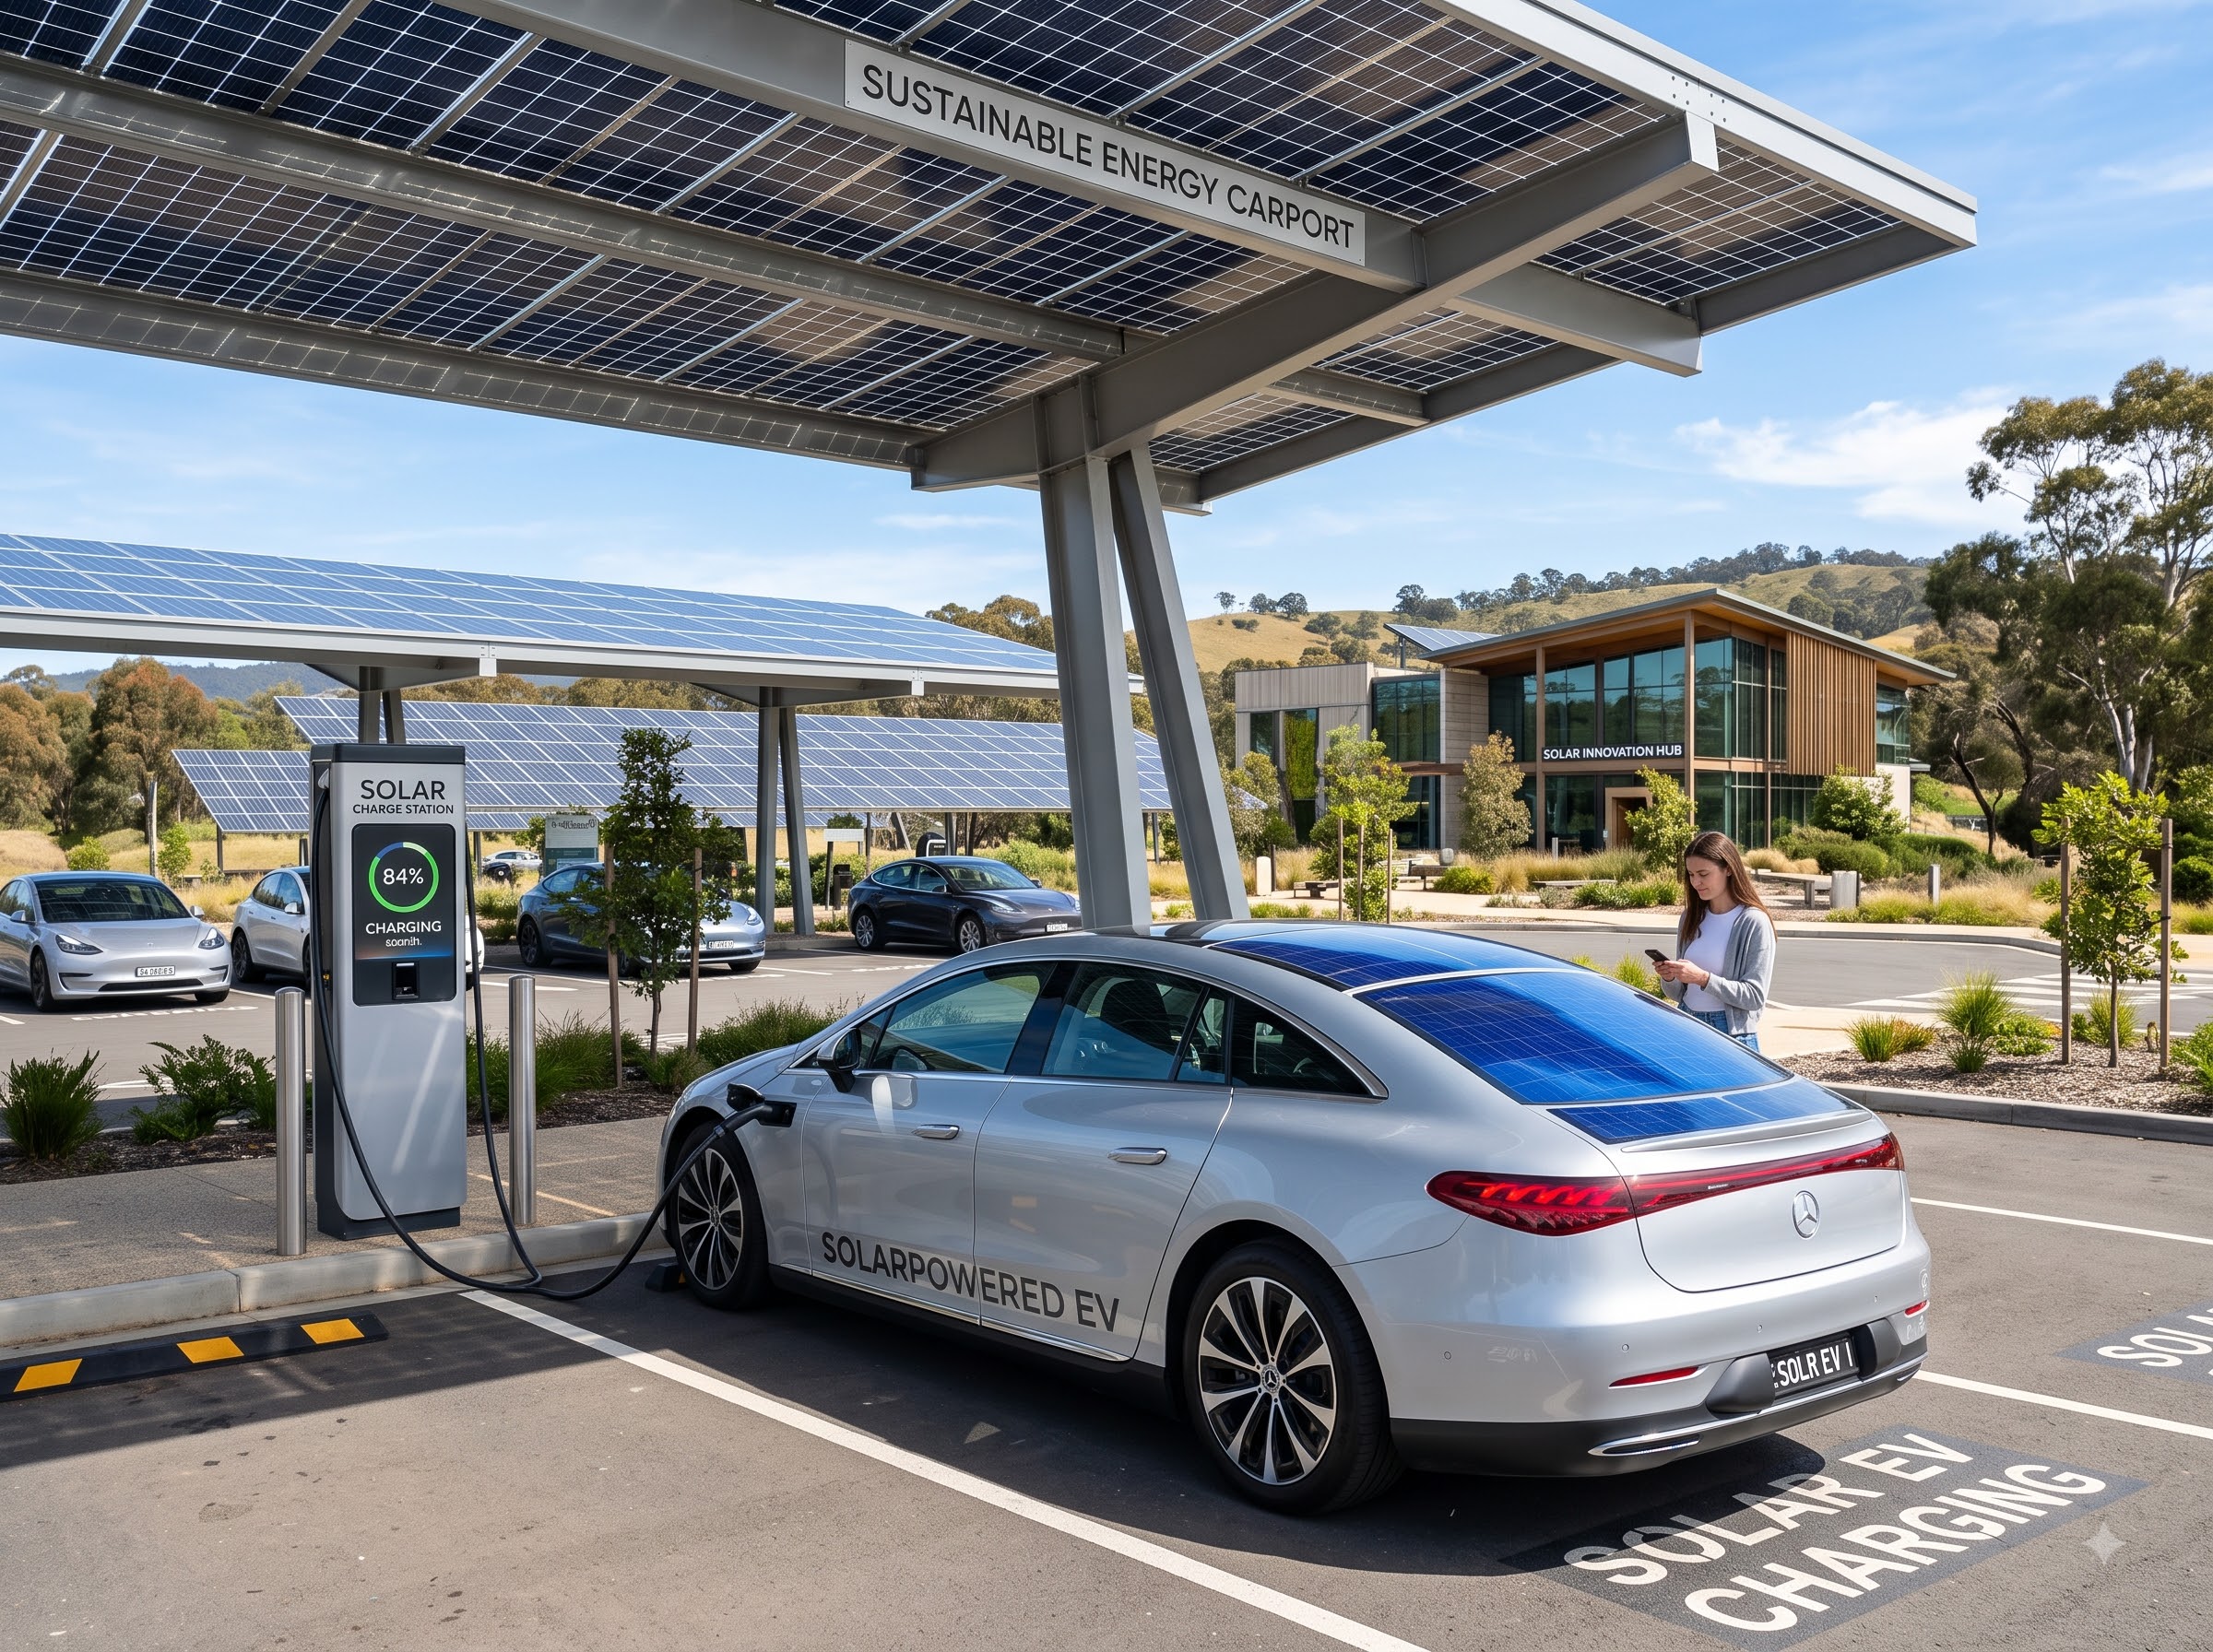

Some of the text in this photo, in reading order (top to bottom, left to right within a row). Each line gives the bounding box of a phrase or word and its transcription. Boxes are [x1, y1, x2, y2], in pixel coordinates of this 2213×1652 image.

[863, 64, 1355, 249] SUSTAINABLE ENERGY CARPORT
[1544, 745, 1683, 760] SOLAR INNOVATION HUB
[361, 780, 445, 800] SOLAR
[352, 804, 454, 815] CHARGE STATION
[383, 867, 424, 885] 84%
[365, 921, 442, 935] CHARGING
[822, 1231, 1119, 1333] SOLARPOWERED EV
[1777, 1352, 1820, 1386] SOLR
[1820, 1345, 1840, 1375] EV
[1564, 1434, 1973, 1585] SOLAR EV
[1685, 1464, 2106, 1631] CHARGING
